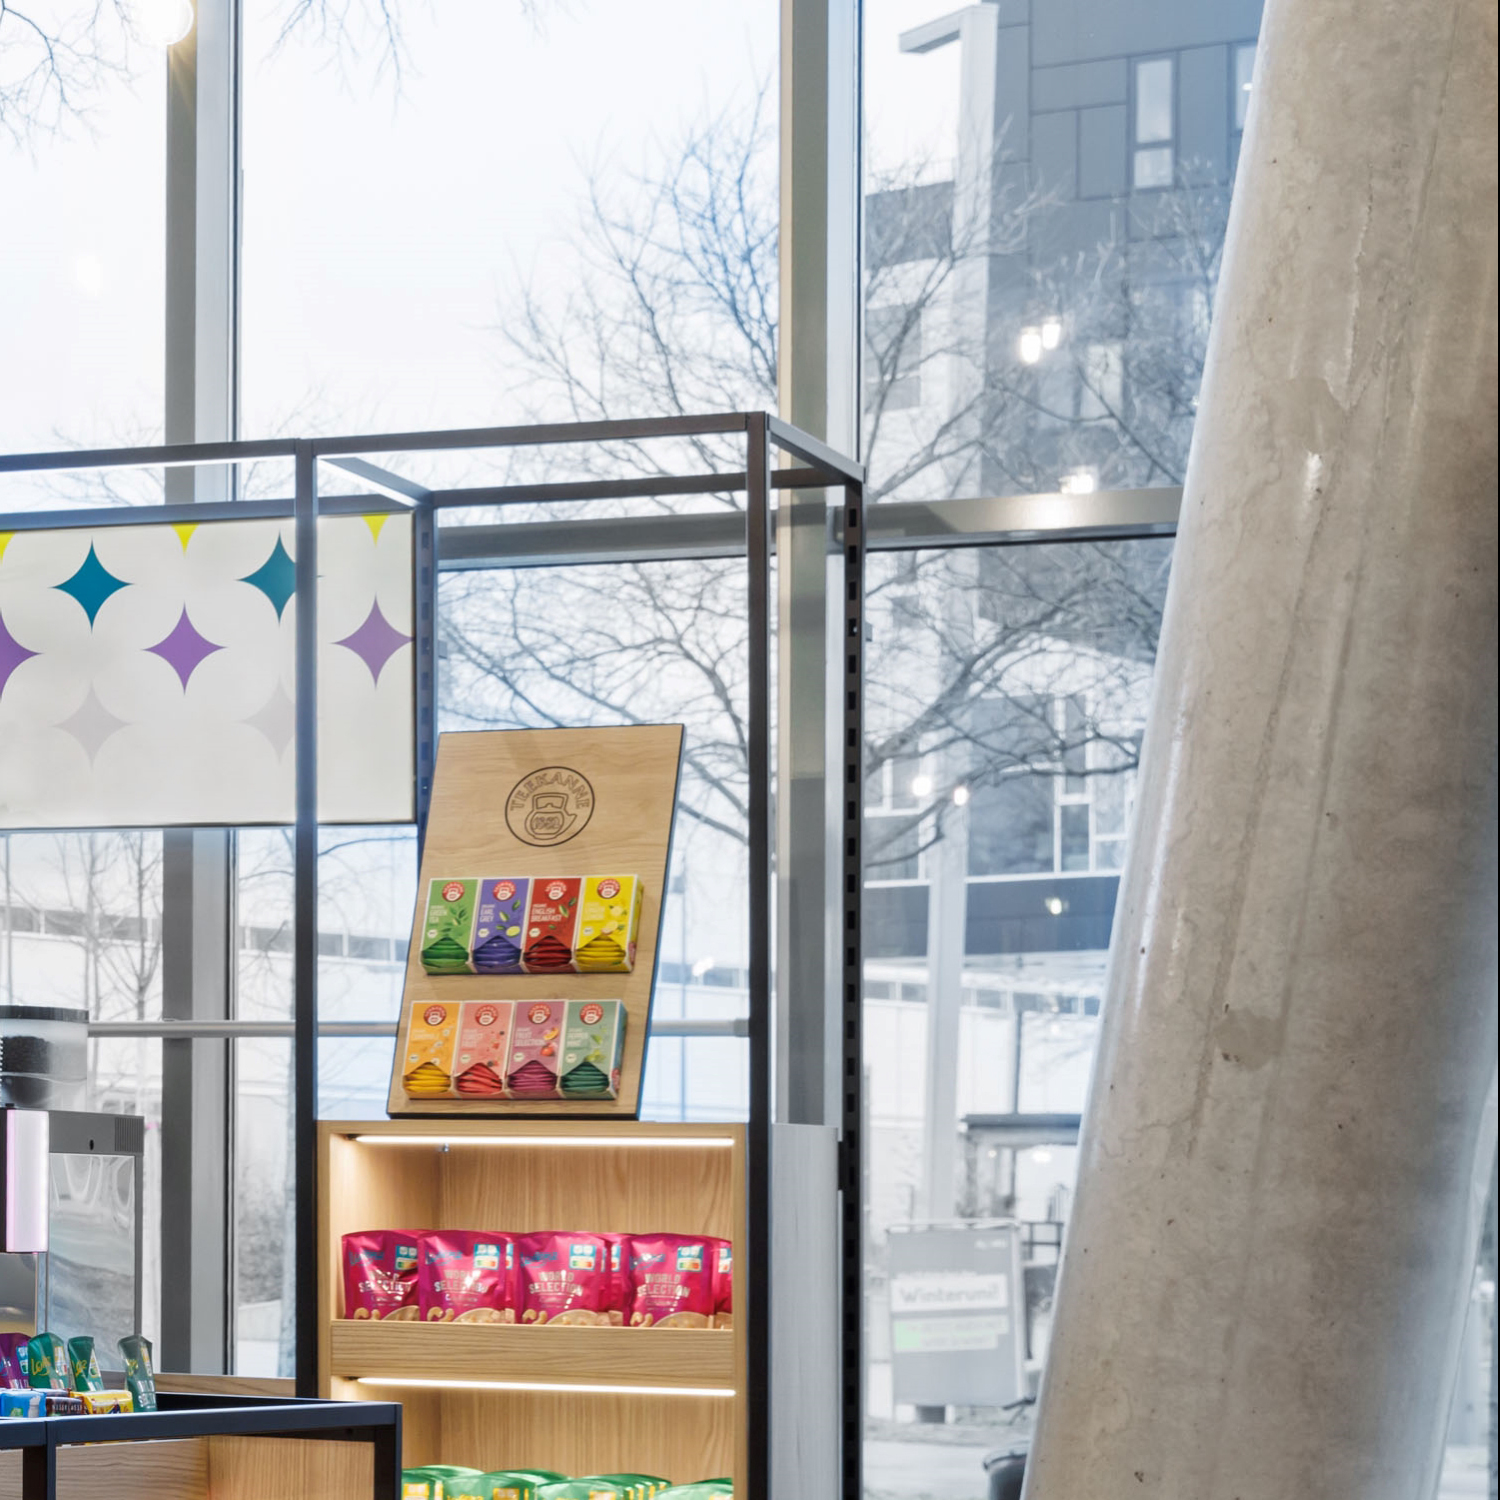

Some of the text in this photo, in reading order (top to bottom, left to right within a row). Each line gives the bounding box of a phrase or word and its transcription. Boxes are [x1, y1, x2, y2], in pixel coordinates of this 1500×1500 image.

[510, 772, 590, 812] TEEKANNE
[529, 1281, 584, 1296] SELECTION
[637, 1284, 690, 1297] SELECTION
